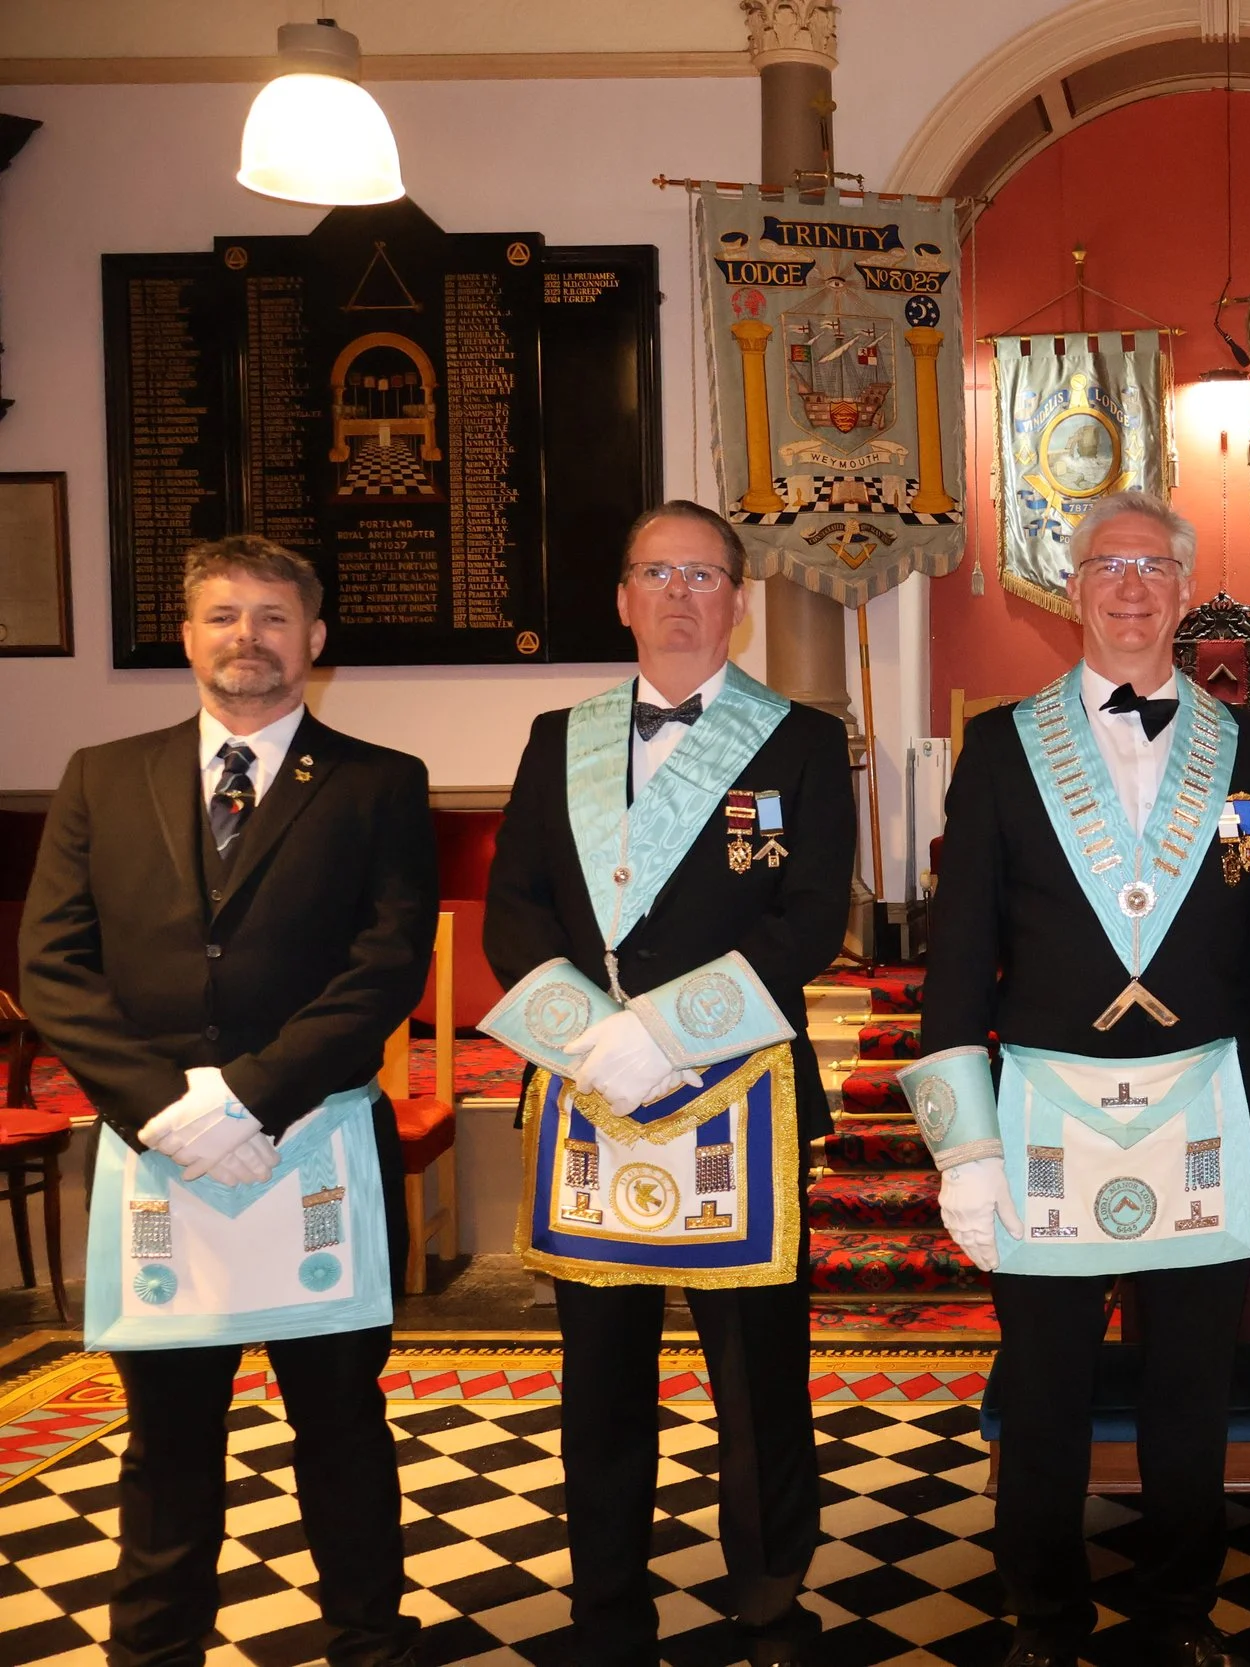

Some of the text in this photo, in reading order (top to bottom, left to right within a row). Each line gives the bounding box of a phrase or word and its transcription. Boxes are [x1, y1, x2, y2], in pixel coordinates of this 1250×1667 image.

[777, 224, 889, 250] TRINITY
[728, 262, 804, 285] LODGE
[1095, 388, 1131, 428] LODGE
[811, 453, 880, 469] WEYMOUTH
[359, 520, 414, 528] PORTLAND
[368, 530, 392, 539] ARCH
